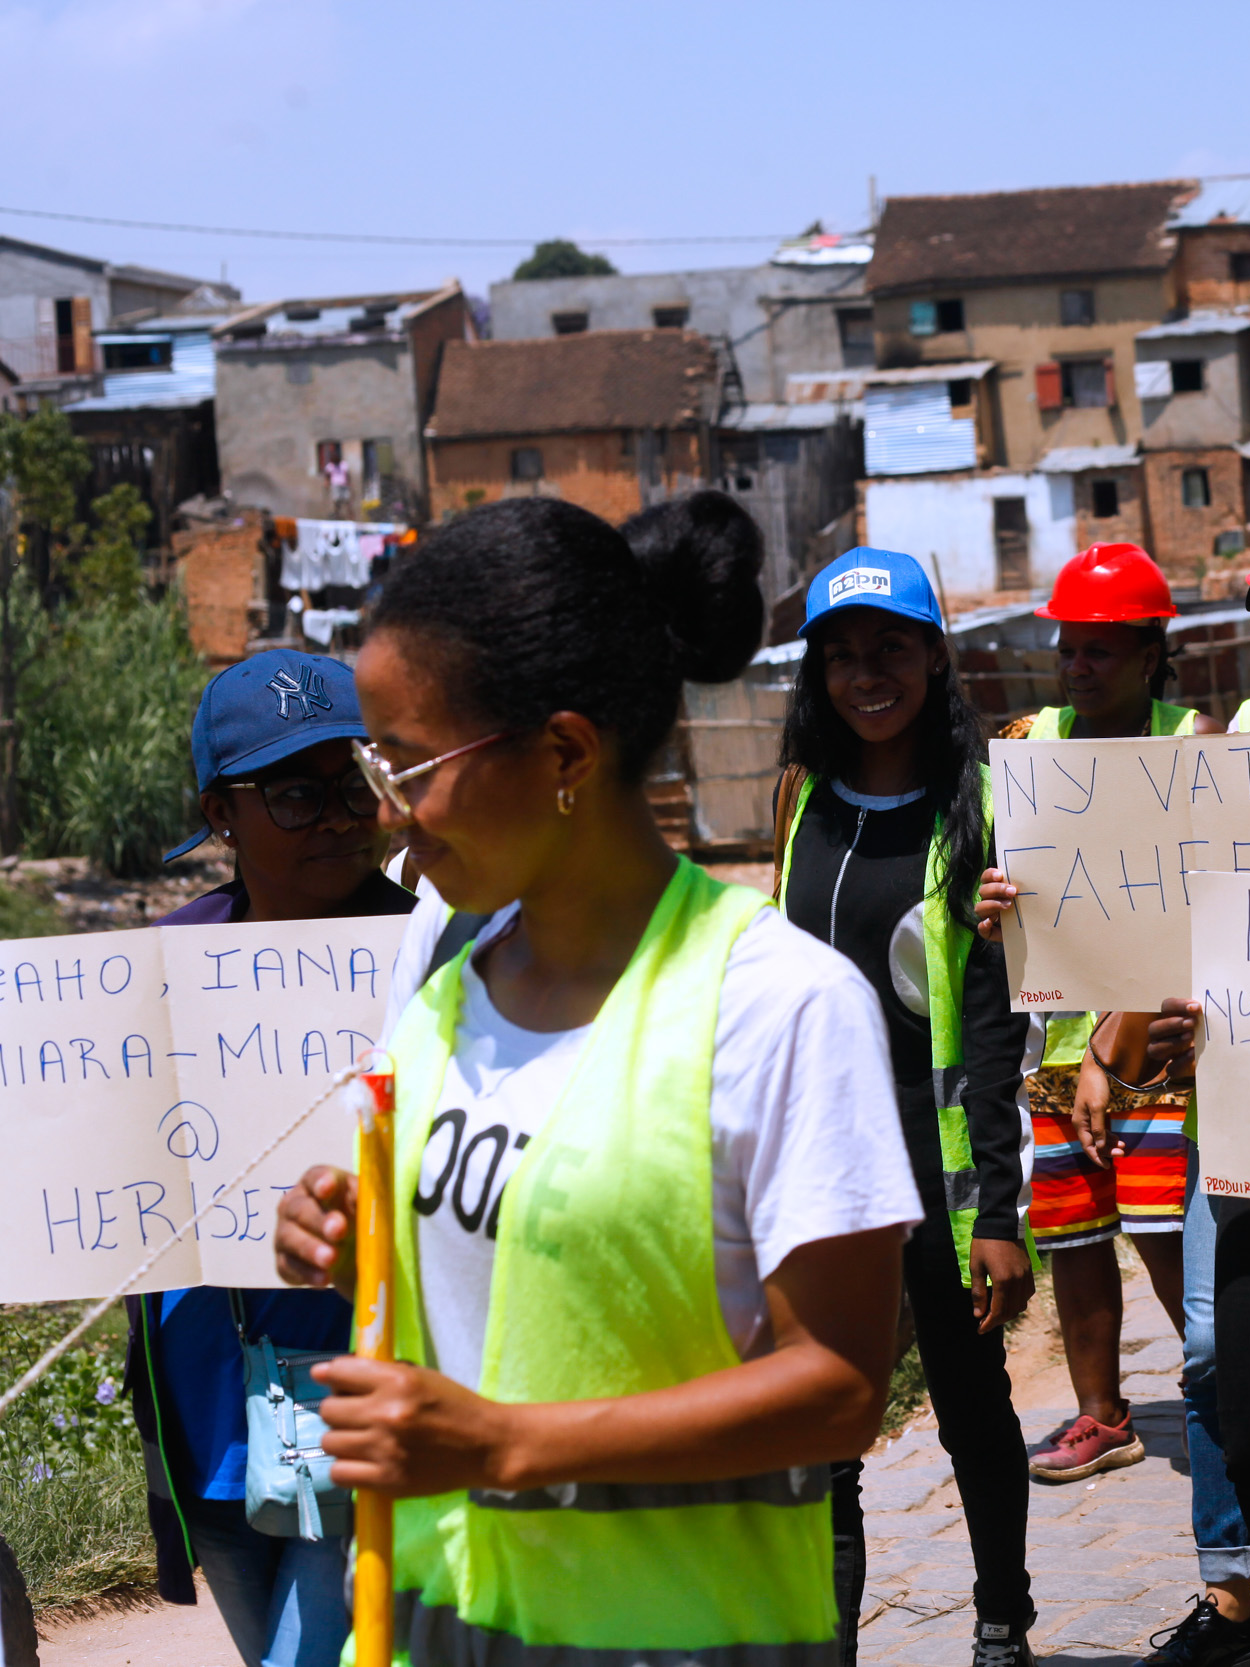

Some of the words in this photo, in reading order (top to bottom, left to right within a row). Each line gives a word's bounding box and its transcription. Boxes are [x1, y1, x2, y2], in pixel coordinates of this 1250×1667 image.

[266, 662, 333, 720] NY
[1004, 756, 1096, 818] NY
[1020, 990, 1064, 1005] PRODUIR
[156, 1100, 220, 1162] @
